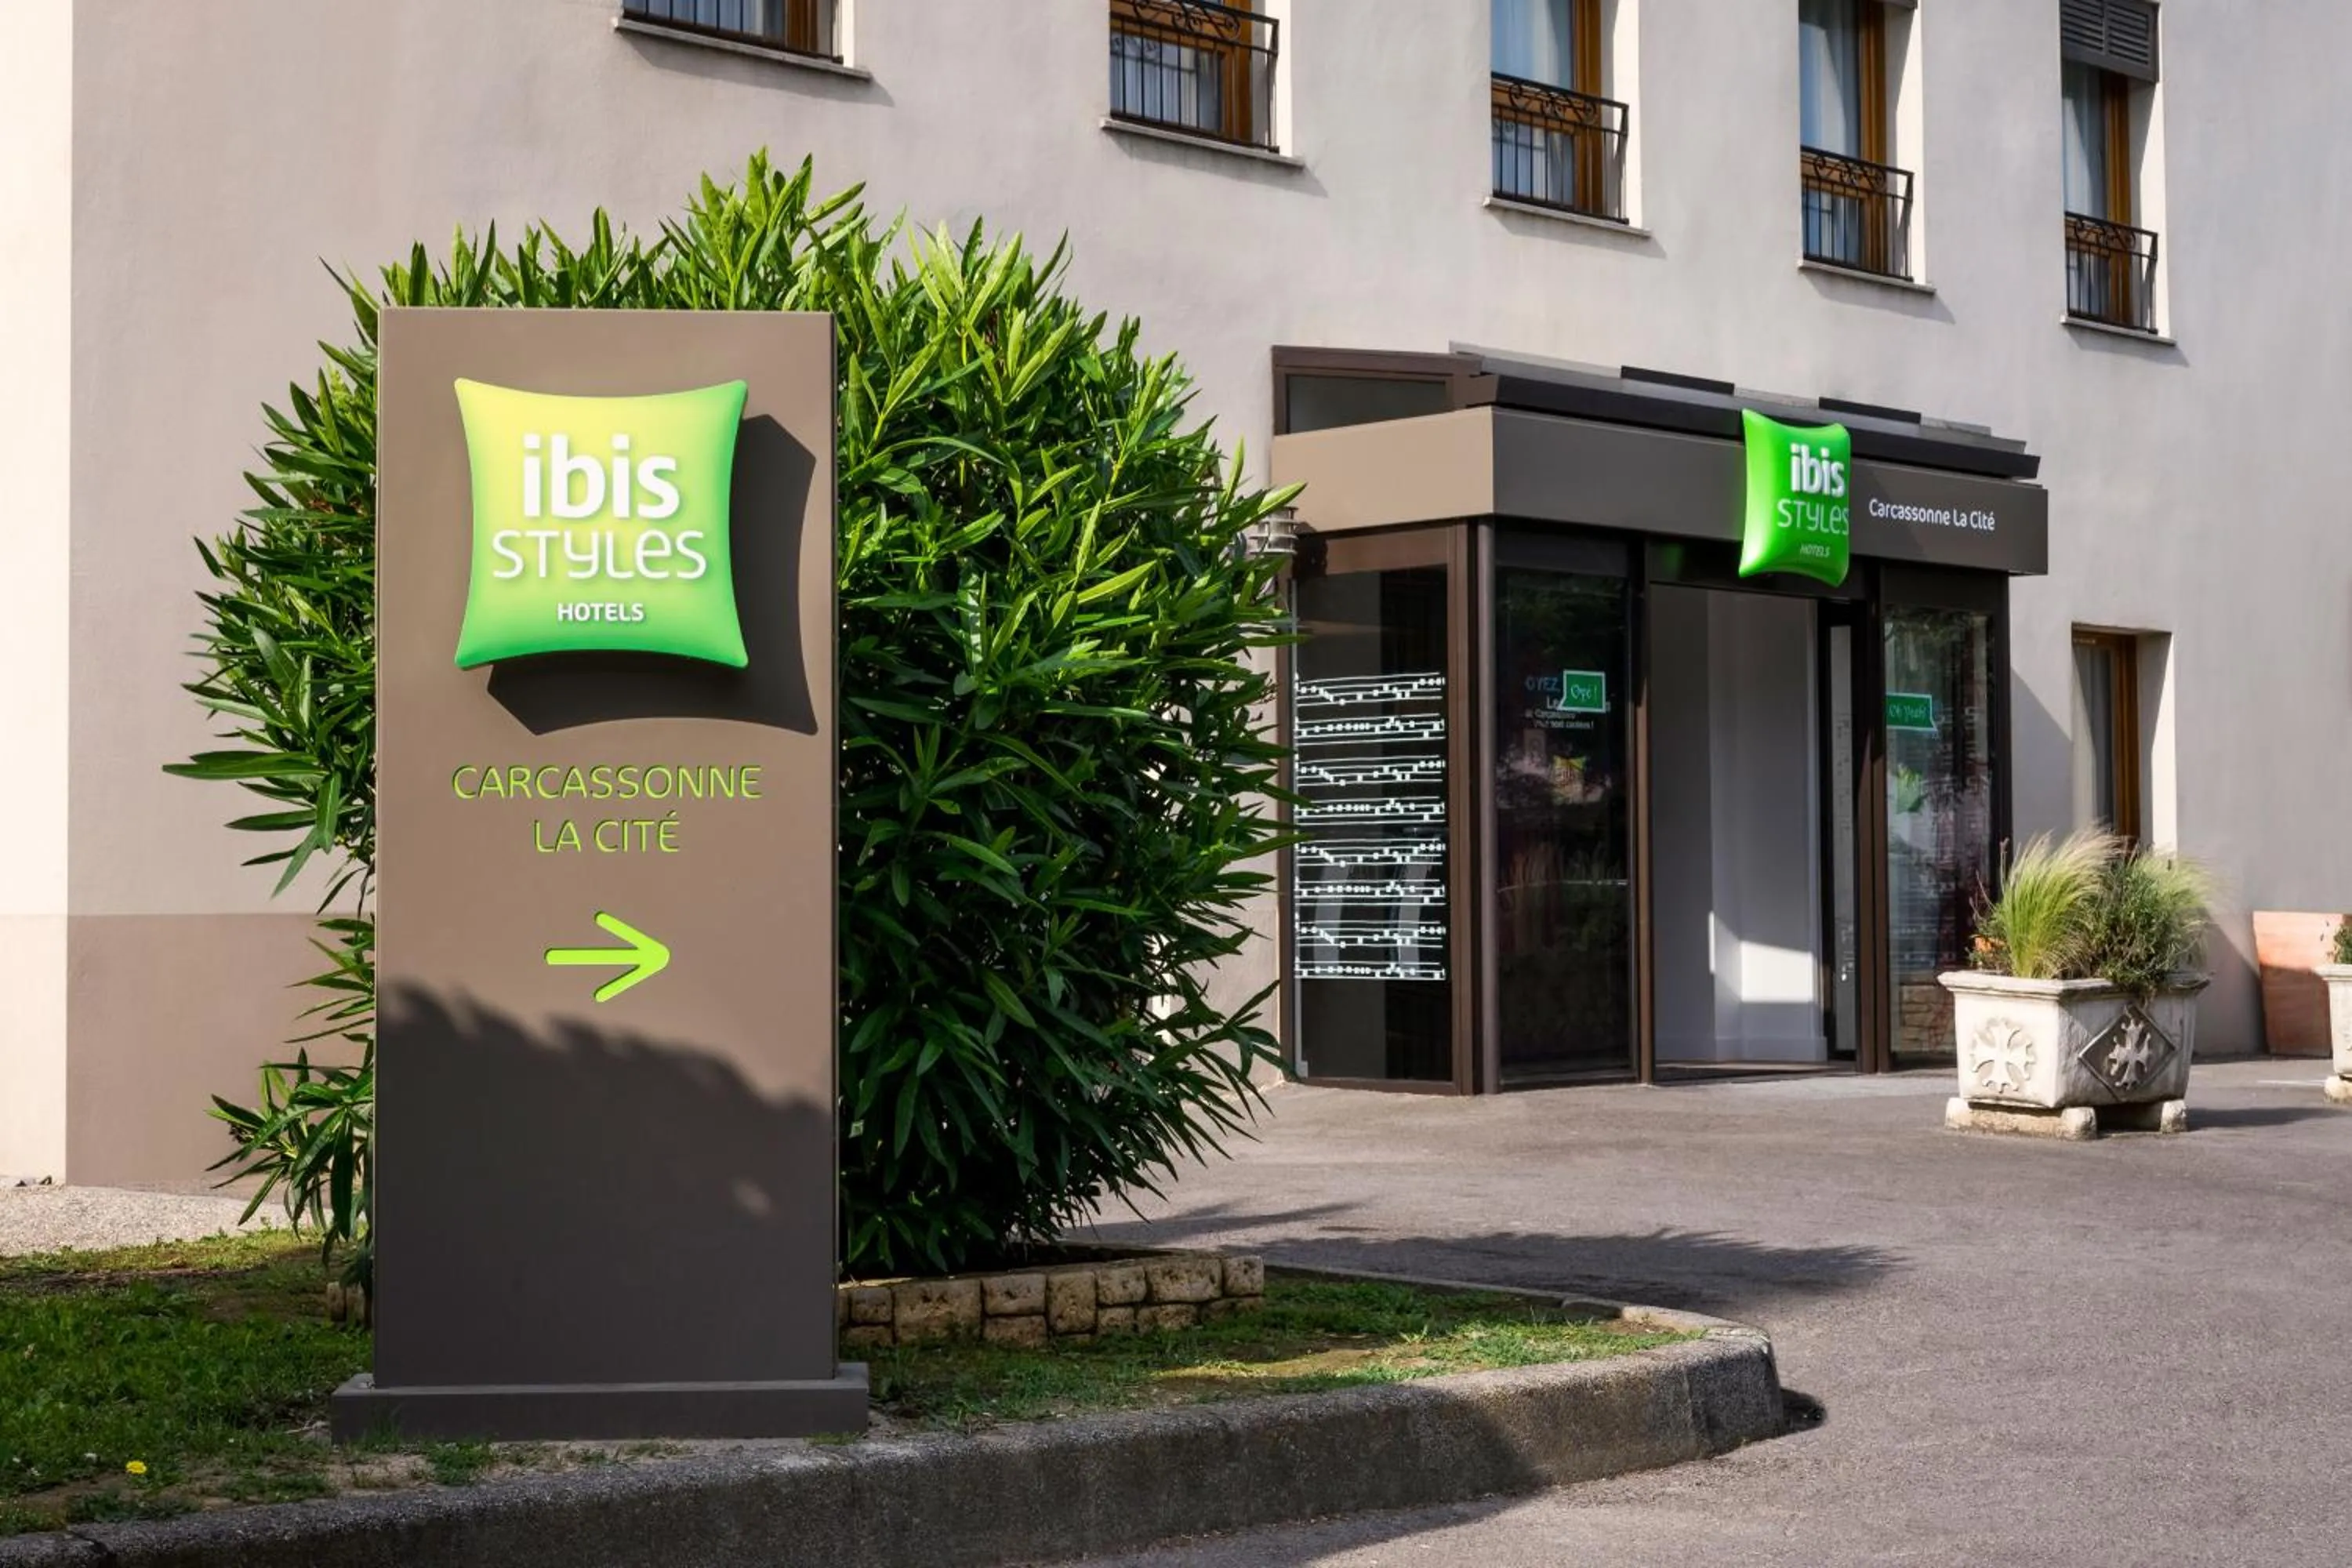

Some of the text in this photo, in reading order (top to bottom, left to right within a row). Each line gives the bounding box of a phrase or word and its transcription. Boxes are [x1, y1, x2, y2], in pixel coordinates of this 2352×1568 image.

[522, 433, 680, 519] ibis
[1790, 442, 1846, 499] ibis
[1868, 497, 1995, 532] Carcassonne La Cité
[1799, 543, 1831, 558] HOTELS
[557, 602, 644, 622] HOTELS
[452, 764, 762, 799] CARCASSONNE
[534, 809, 680, 853] LA CITÉ
